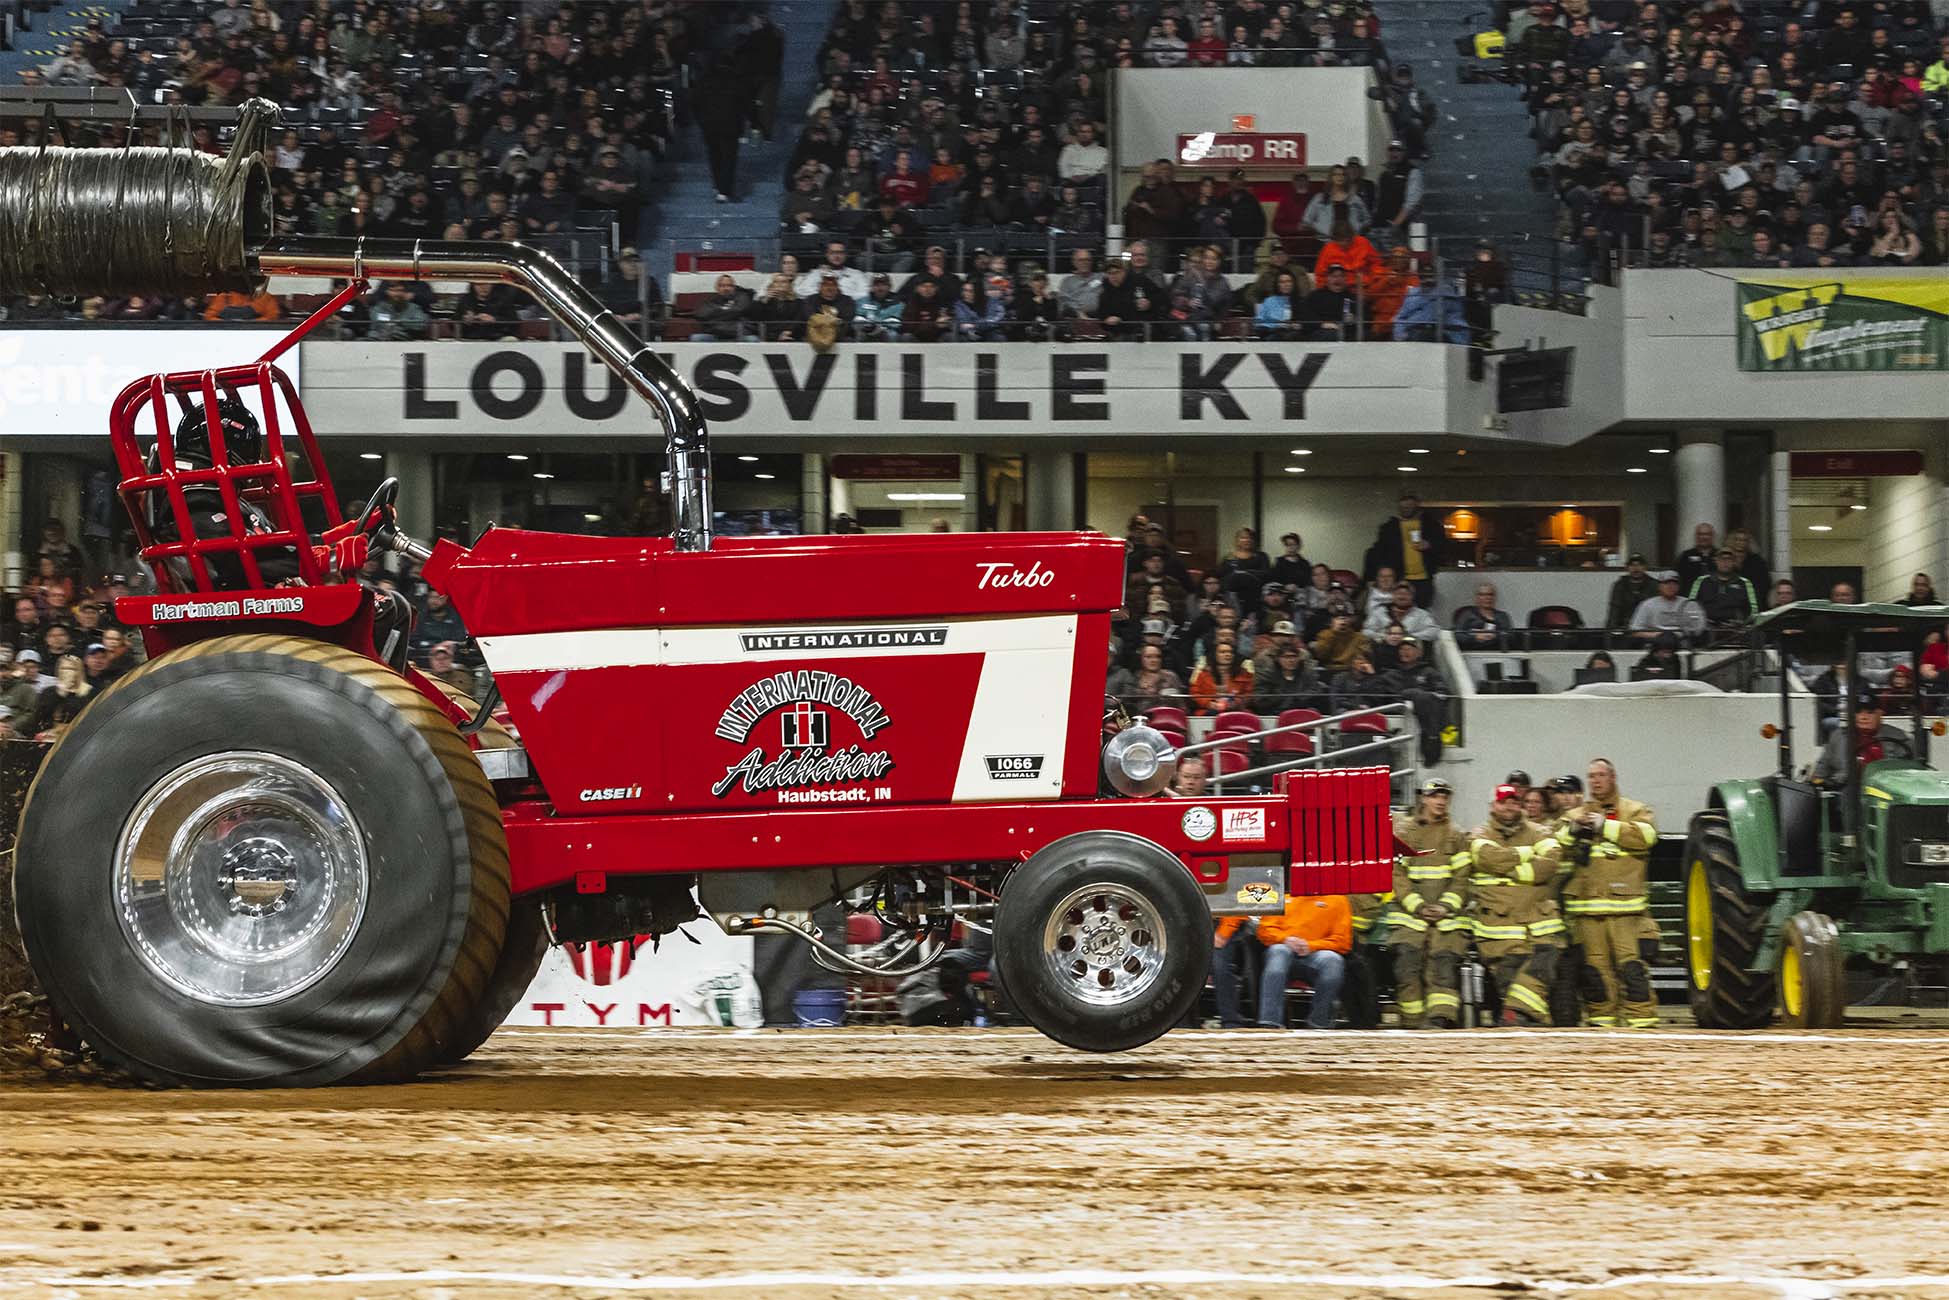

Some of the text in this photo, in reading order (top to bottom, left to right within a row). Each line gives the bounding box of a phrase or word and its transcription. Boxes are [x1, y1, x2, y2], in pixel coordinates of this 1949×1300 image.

[1184, 140, 1298, 161] amp RR
[404, 351, 1331, 421] LOUSVILLE KY
[976, 561, 1055, 589] Turbo
[153, 597, 304, 620] Hartman Farms
[748, 632, 941, 649] INTERNATIONAL
[715, 670, 890, 743] INTERNATIONAL
[712, 744, 892, 796] Addiction
[998, 758, 1032, 770] 1066
[580, 787, 625, 801] CASE
[778, 788, 891, 802] Haubstadt, IN
[1230, 810, 1258, 828] HPS
[531, 1003, 671, 1025] TYM
